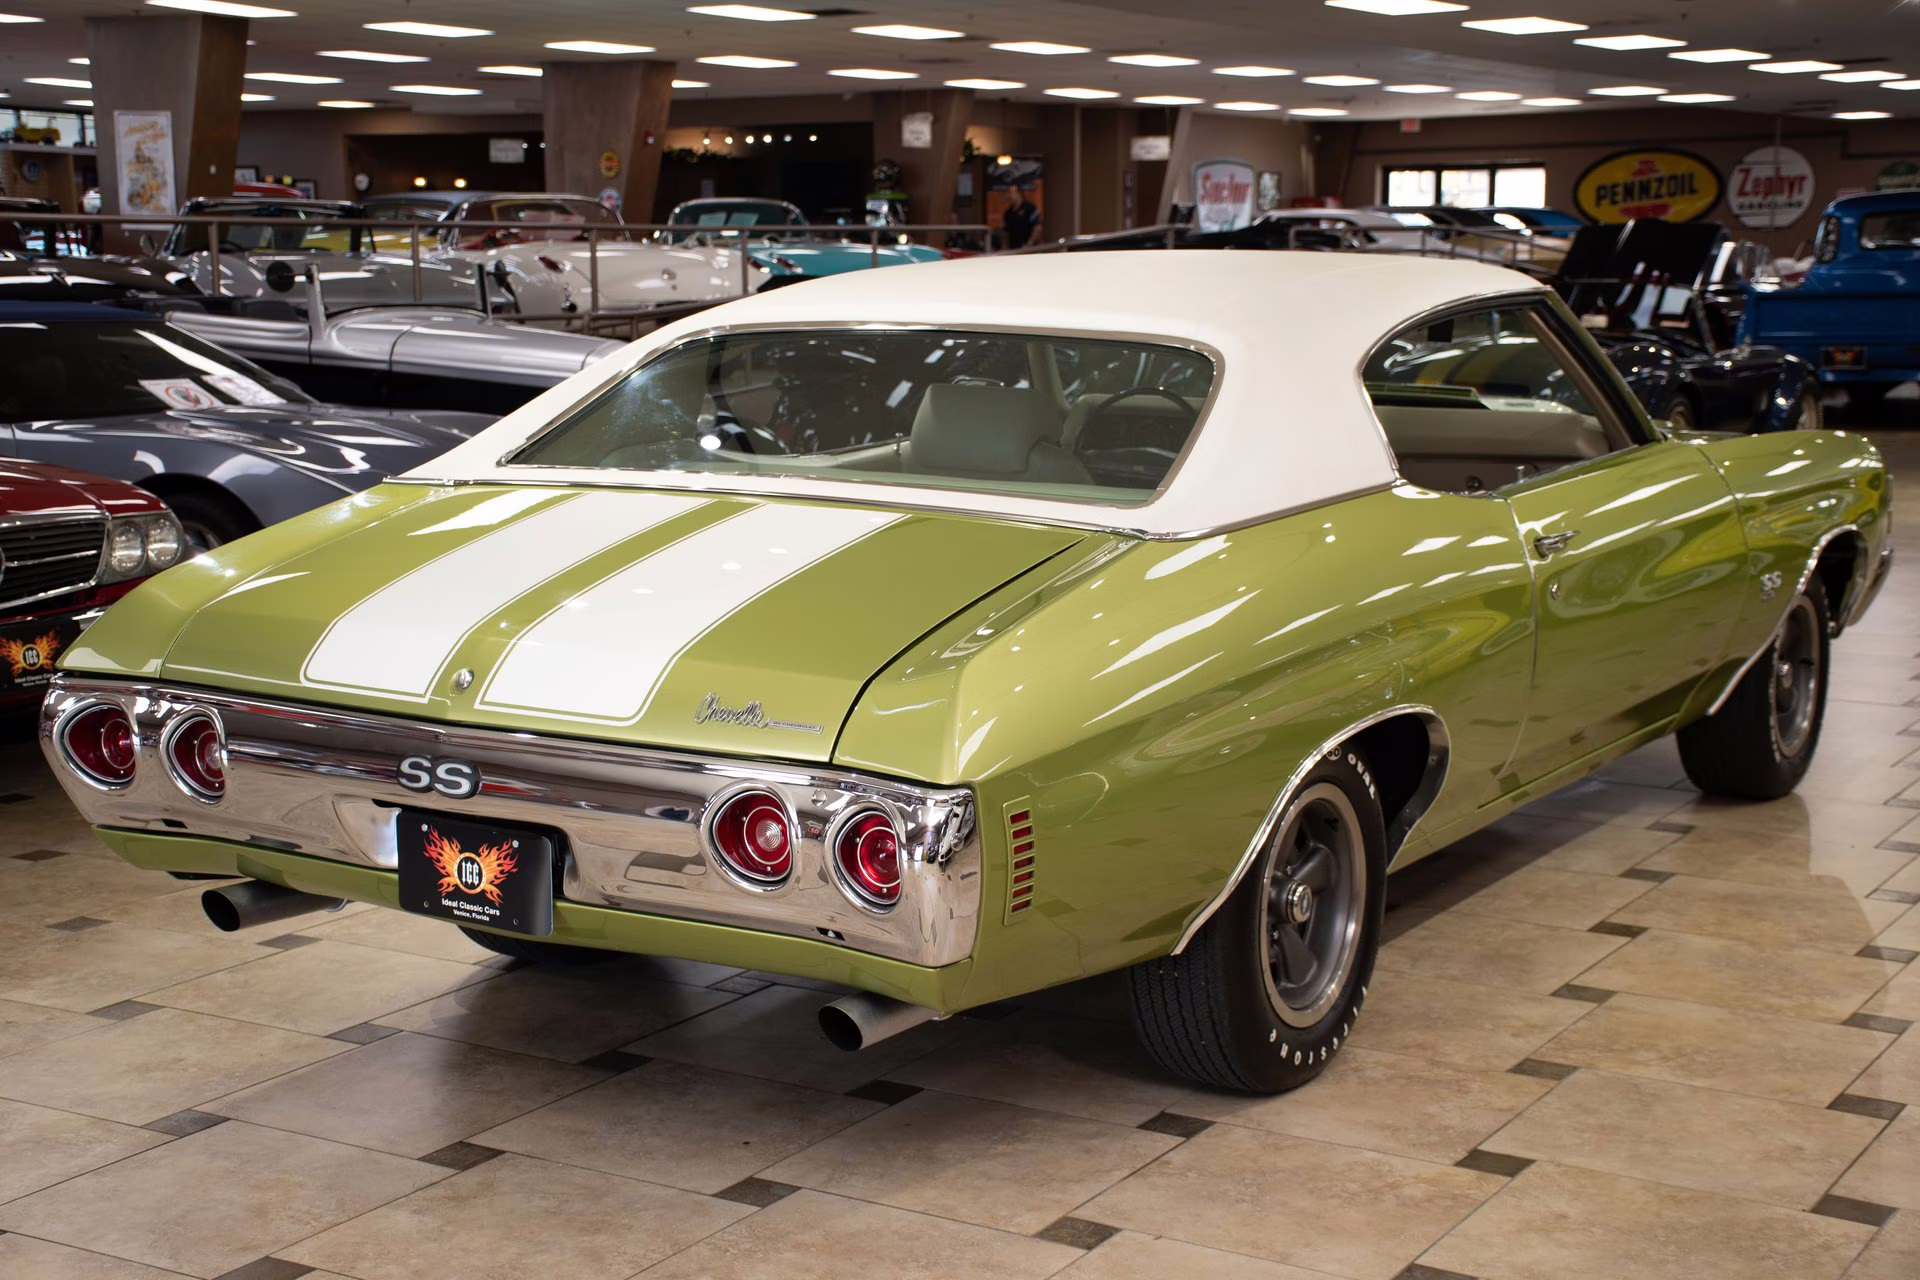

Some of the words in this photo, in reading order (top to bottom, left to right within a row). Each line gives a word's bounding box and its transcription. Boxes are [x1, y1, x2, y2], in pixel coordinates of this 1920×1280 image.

[1596, 172, 1698, 208] PENNZOIL
[1737, 167, 1808, 200] Zephyr
[694, 692, 769, 729] Chevelle
[399, 756, 472, 796] SS
[1347, 753, 1375, 799] OVAL
[462, 860, 480, 886] ICC
[441, 898, 458, 908] Ideal
[459, 901, 483, 913] Classic
[484, 906, 500, 916] Cars
[453, 909, 472, 918] Venice,
[472, 912, 490, 921] Florida
